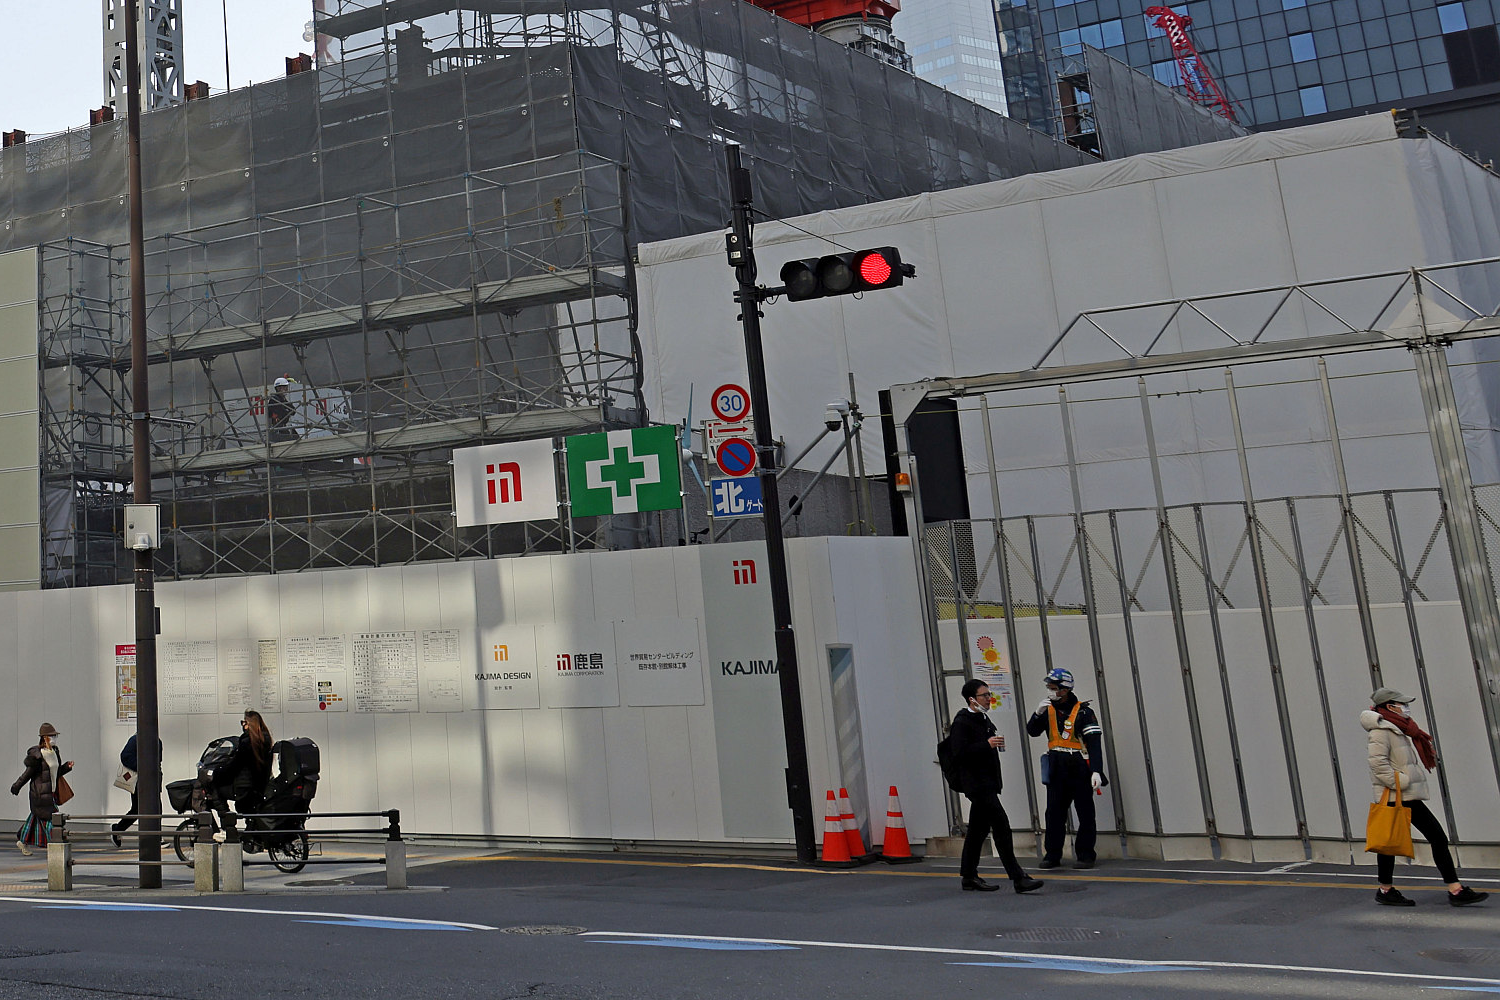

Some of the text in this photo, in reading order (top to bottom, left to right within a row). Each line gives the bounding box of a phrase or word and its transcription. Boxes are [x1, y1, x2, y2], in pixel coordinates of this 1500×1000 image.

[720, 394, 742, 412] 30
[715, 481, 763, 514] 北ゲート
[574, 653, 603, 670] 鹿島
[474, 672, 532, 681] KAJIMA DESIGN
